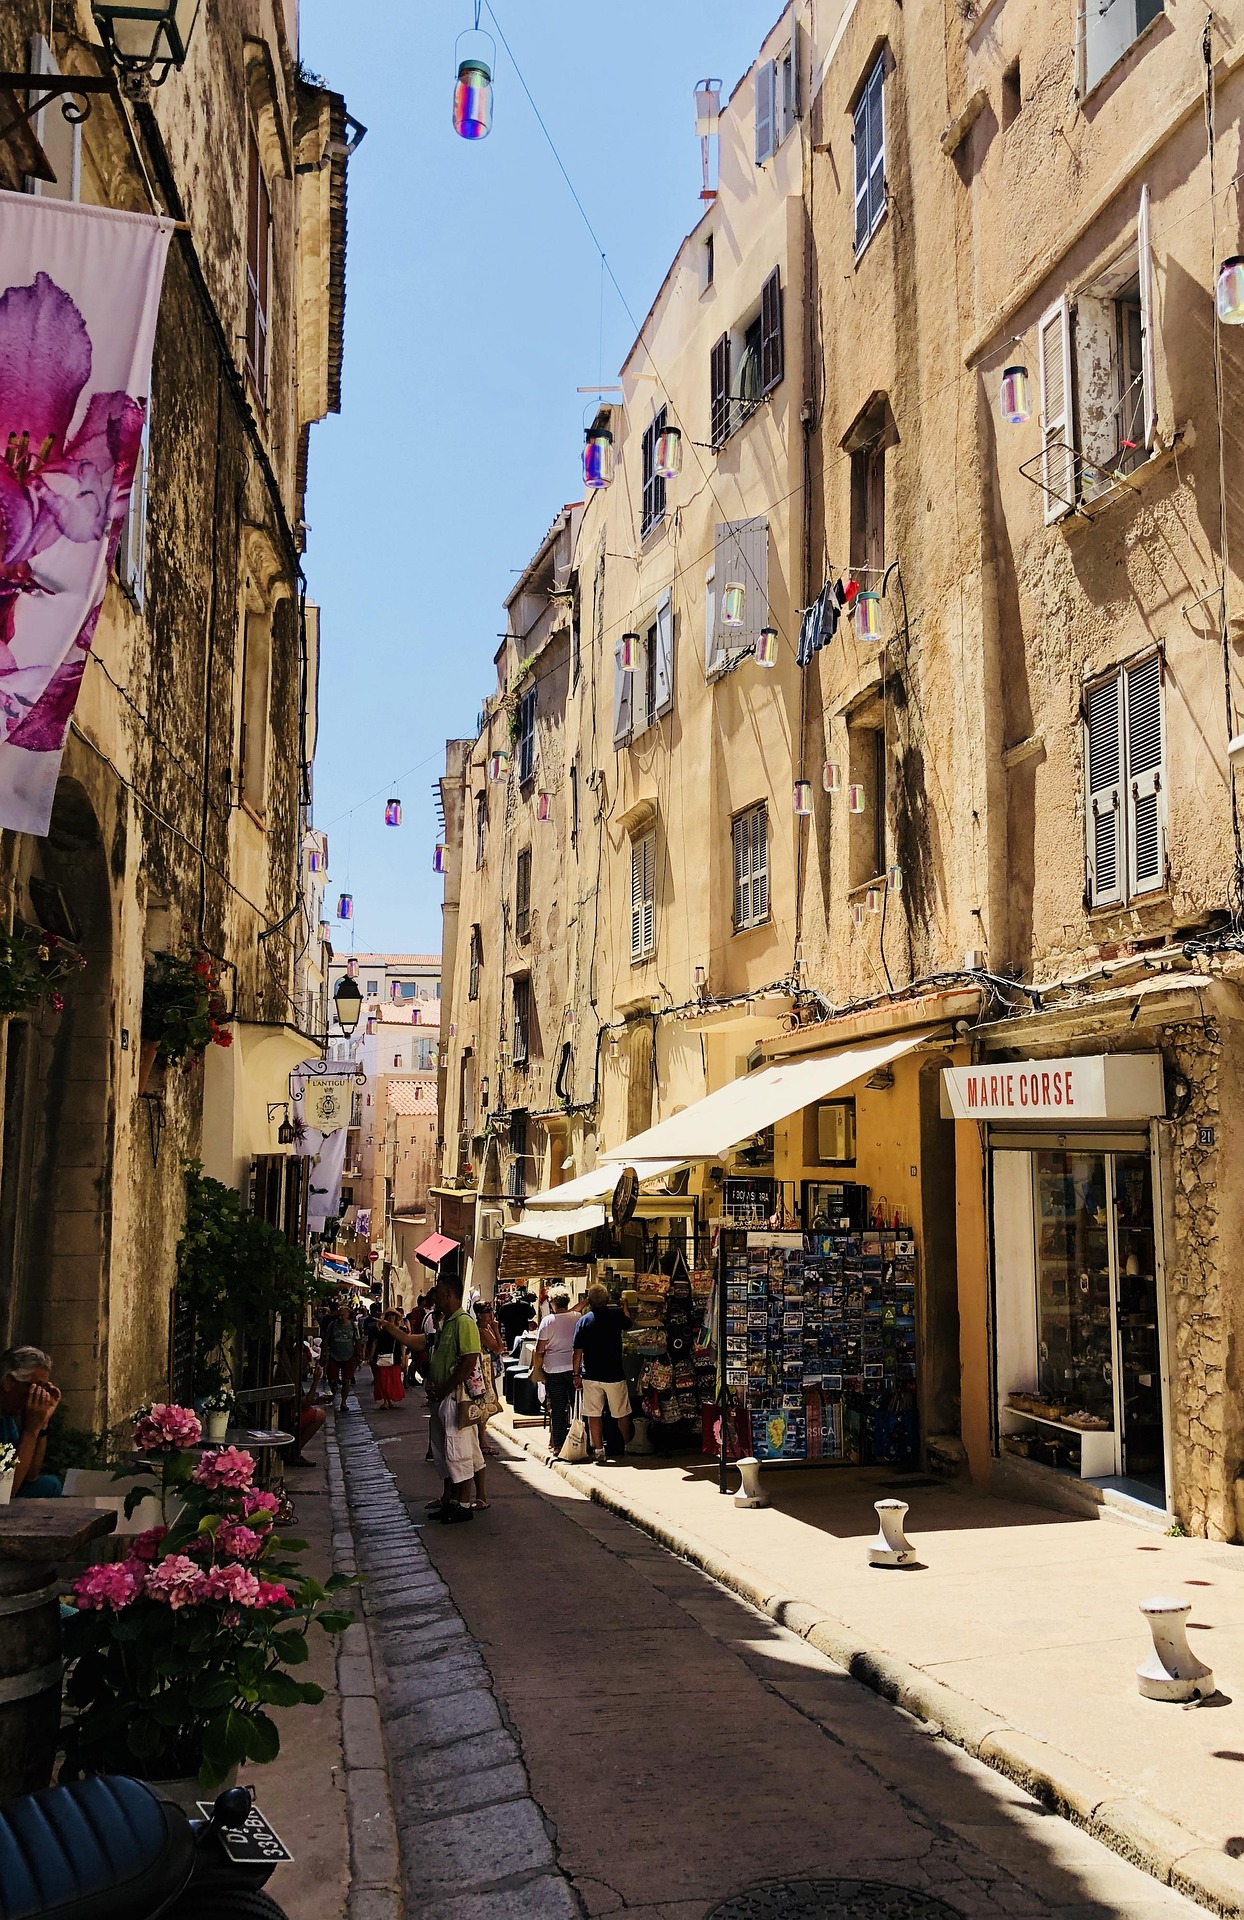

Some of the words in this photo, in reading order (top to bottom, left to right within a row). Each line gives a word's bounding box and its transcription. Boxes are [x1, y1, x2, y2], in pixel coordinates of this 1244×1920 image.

[967, 1073, 1015, 1107] MARIE
[1019, 1071, 1075, 1106] CORSE
[1201, 1130, 1211, 1143] 21
